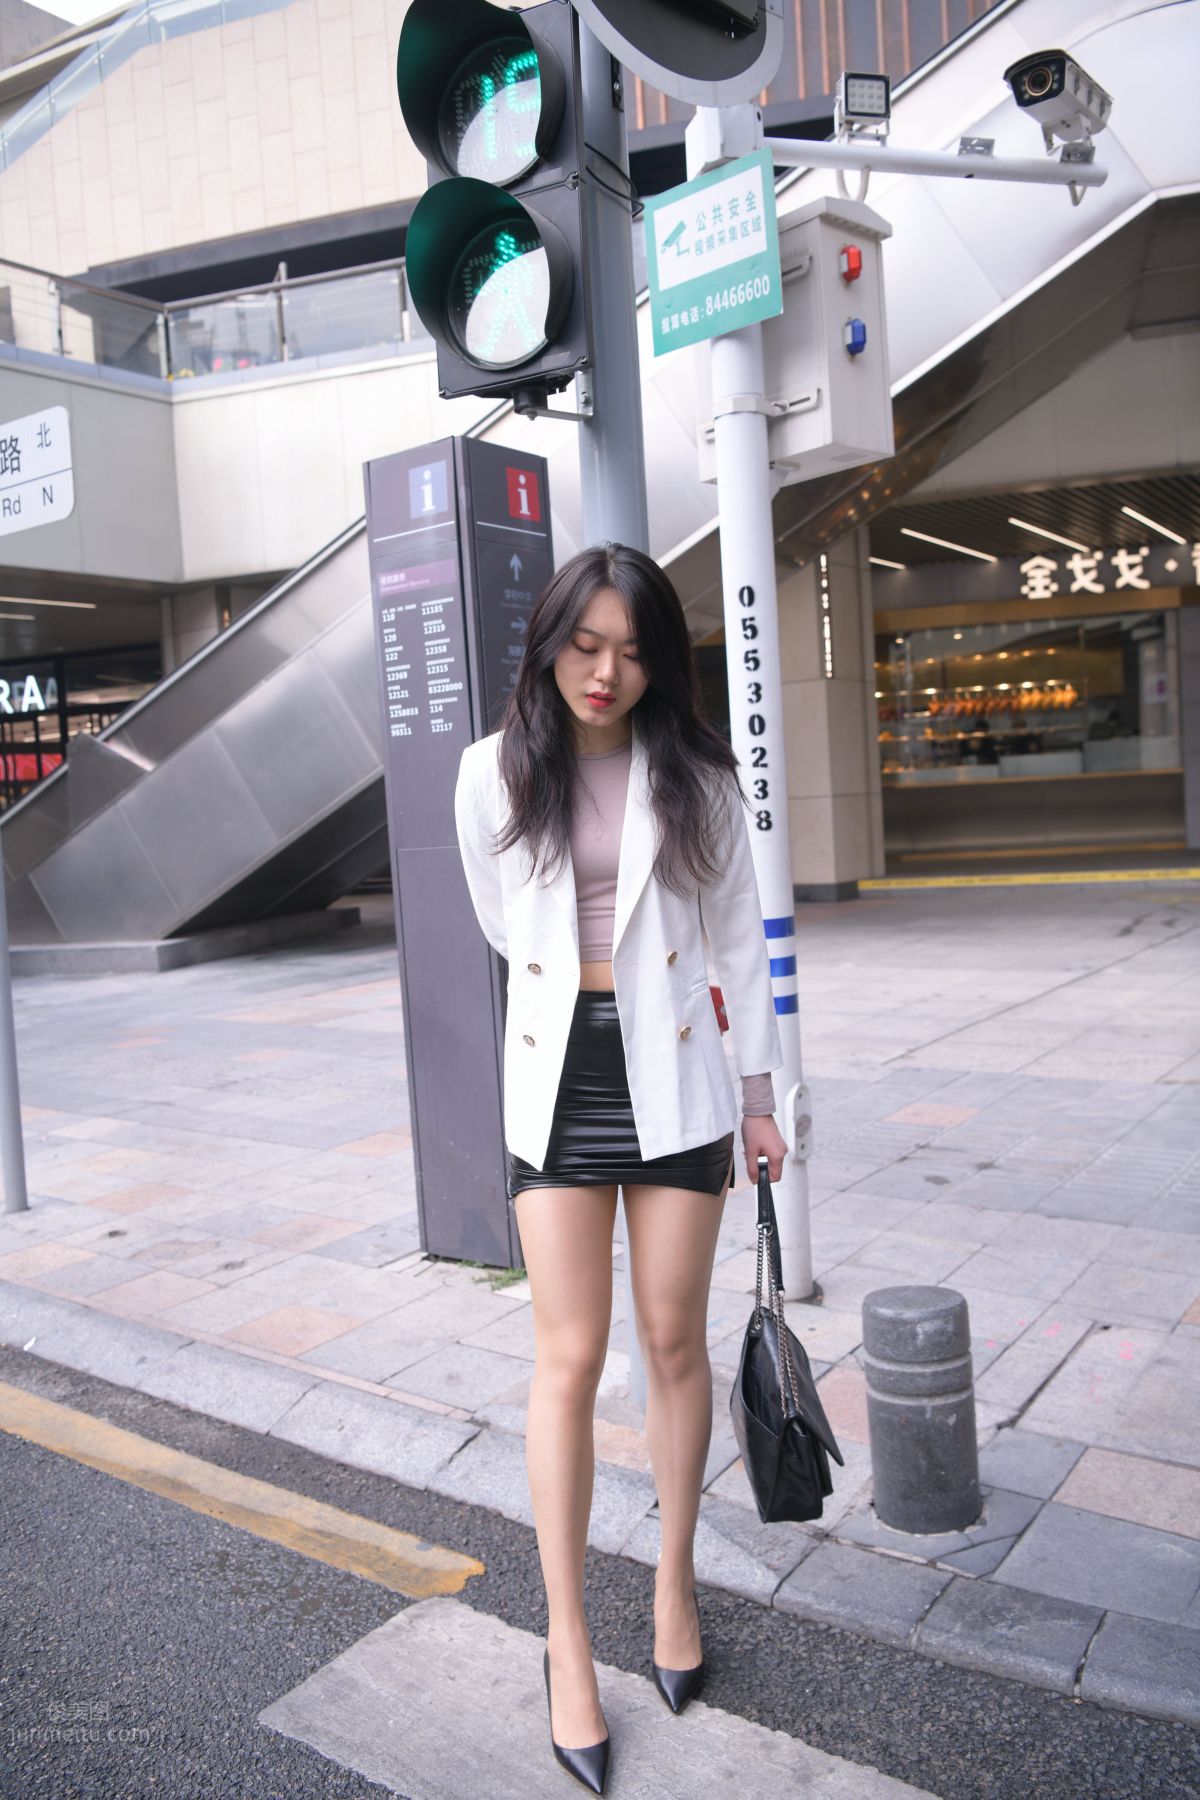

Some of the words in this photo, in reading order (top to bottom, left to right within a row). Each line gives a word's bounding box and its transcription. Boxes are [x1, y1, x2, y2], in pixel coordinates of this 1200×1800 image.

[696, 191, 757, 232] 公共安全
[694, 215, 763, 257] 视频采集区域
[0, 435, 21, 475] 路
[36, 422, 52, 449] 北
[2, 494, 21, 517] Rd
[42, 485, 54, 506] N
[382, 613, 396, 622] 110
[384, 634, 397, 643] 120
[385, 652, 398, 662] 122
[426, 664, 449, 675] 12315
[387, 671, 408, 682] 12369
[388, 690, 409, 700] 12121
[430, 704, 443, 714] 114
[739, 586, 772, 831] 05530238
[431, 722, 453, 733] 12117
